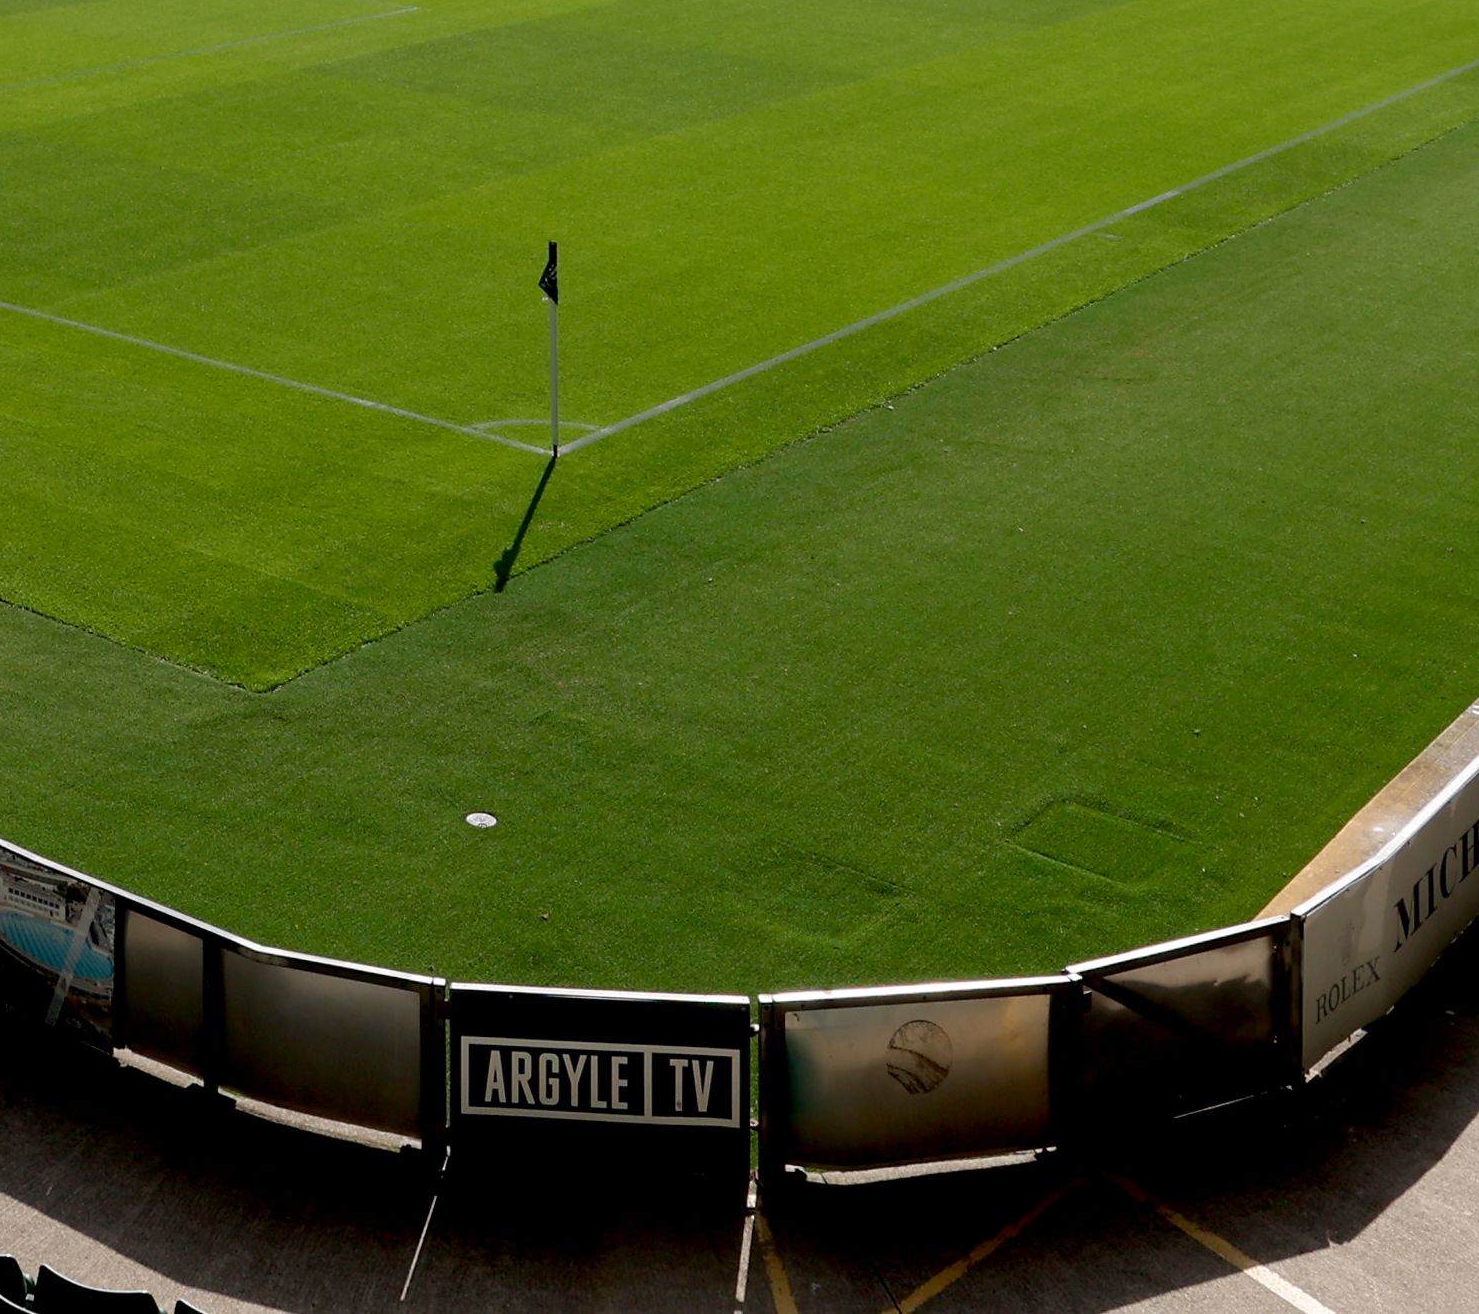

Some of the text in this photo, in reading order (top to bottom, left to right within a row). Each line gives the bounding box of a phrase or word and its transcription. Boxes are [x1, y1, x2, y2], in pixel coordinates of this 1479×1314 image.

[1316, 956, 1381, 1024] ROLEX
[484, 1050, 715, 1113] ARGYLE TV
